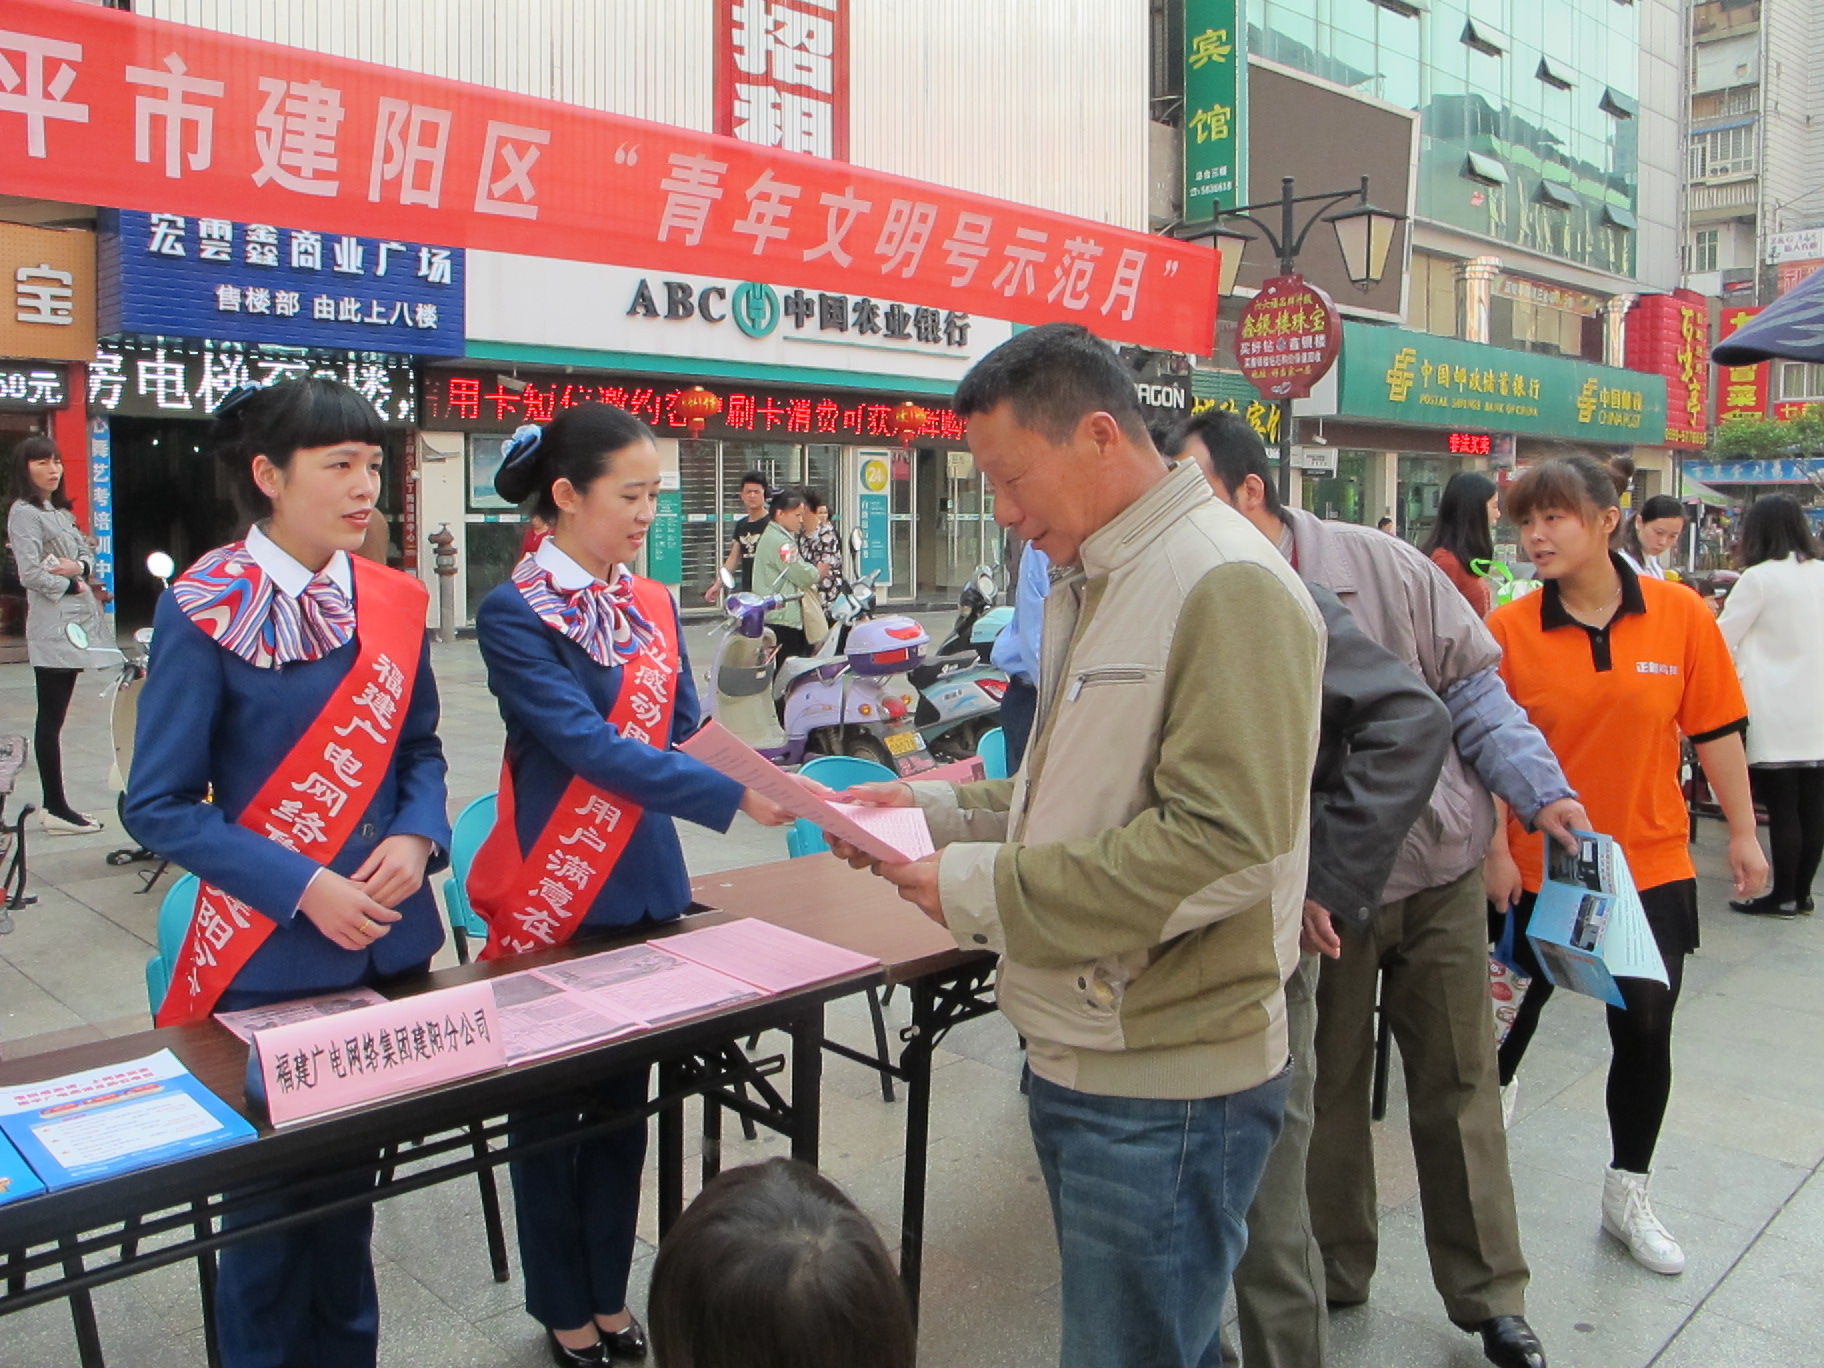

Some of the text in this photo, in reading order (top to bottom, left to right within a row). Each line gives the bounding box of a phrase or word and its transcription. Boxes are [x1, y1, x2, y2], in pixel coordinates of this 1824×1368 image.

[1189, 29, 1233, 144] 宾馆
[16, 264, 74, 325] 宝
[215, 284, 440, 329] 售楼部 由此上八楼
[626, 278, 972, 347] ABC 中国农业银行
[1136, 383, 1185, 409] AGON
[1420, 359, 1541, 401] 中国邮政储蓄银行
[275, 1007, 492, 1095] 福建广电网络集团建阳分公司
